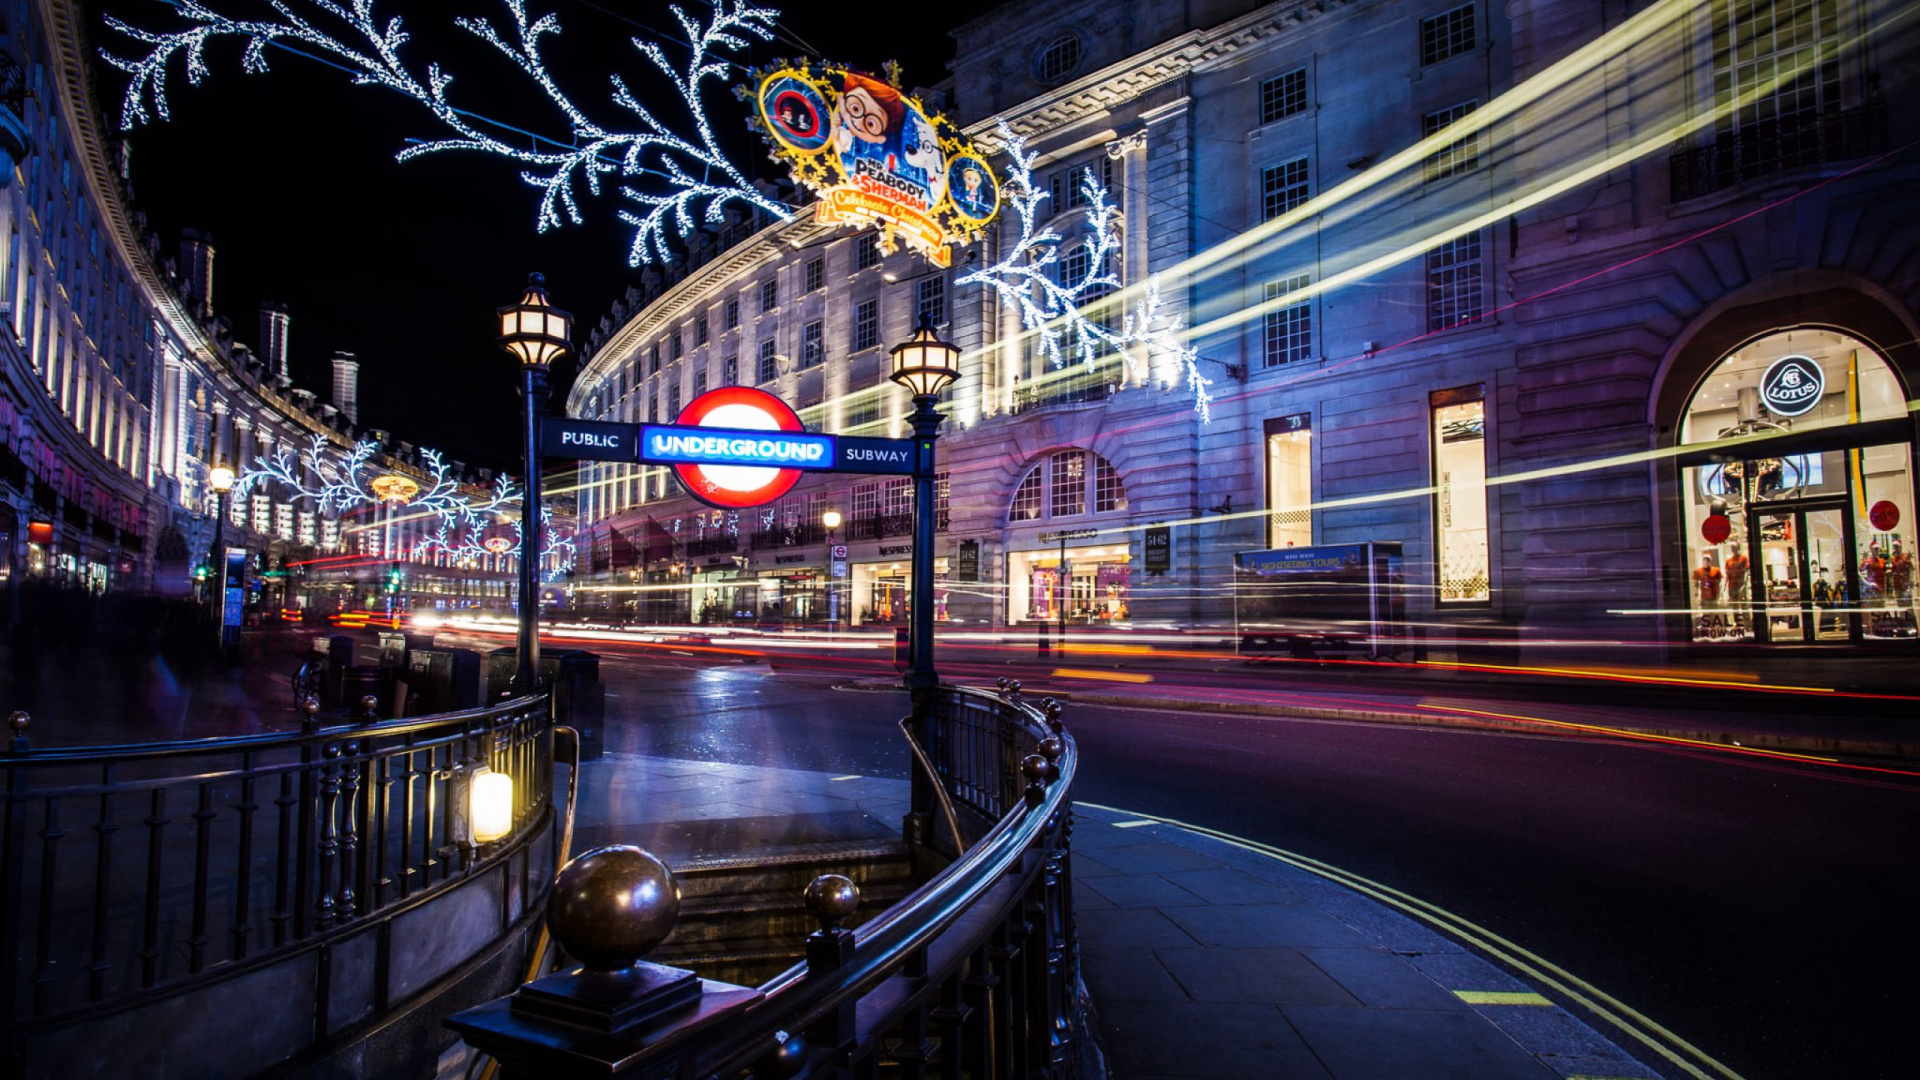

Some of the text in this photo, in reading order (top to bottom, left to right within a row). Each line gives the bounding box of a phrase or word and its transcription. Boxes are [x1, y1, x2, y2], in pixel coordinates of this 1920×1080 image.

[855, 159, 924, 199] PEABODY
[861, 175, 926, 212] SHERMAN
[1770, 382, 1816, 399] LOTUS
[562, 431, 619, 448] PUBLIC
[654, 434, 824, 462] UNDERGROUND
[846, 448, 908, 463] SUBWAY
[1261, 557, 1340, 571] SIGHTSEEING TOURS
[1701, 614, 1744, 627] SALE
